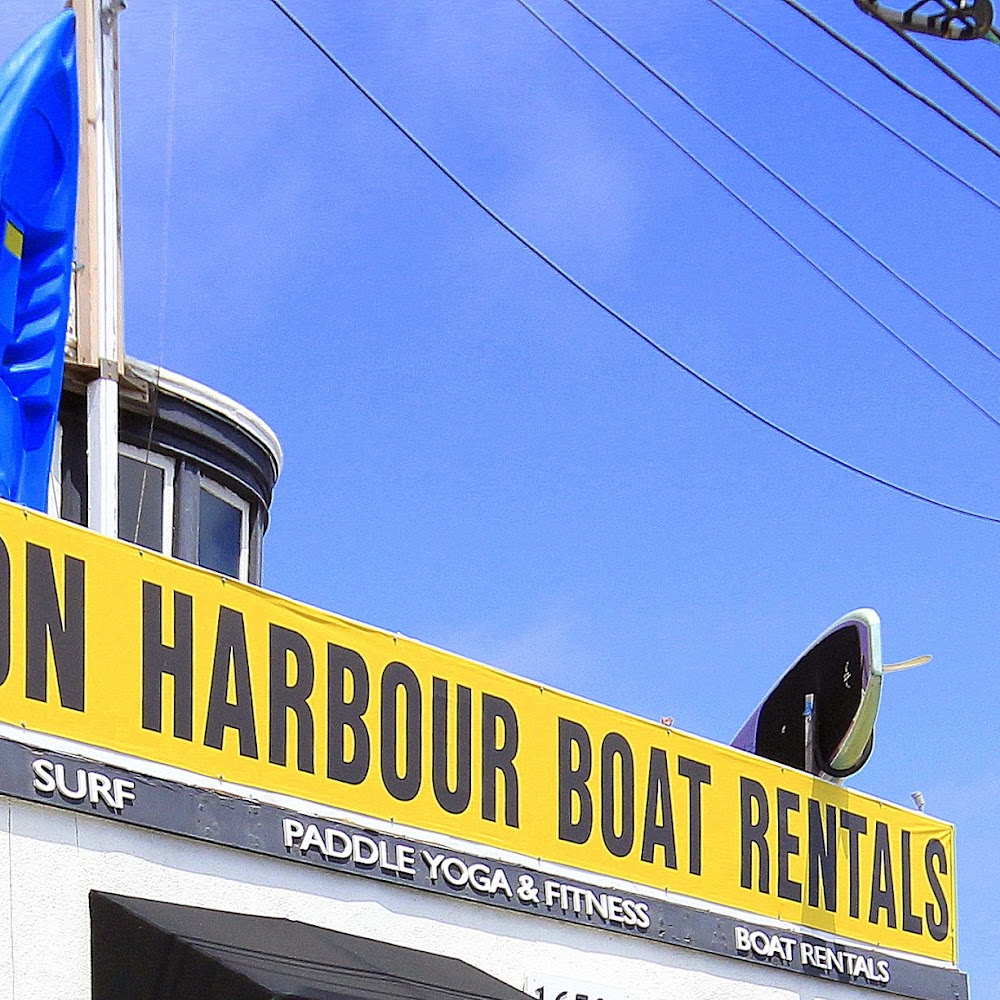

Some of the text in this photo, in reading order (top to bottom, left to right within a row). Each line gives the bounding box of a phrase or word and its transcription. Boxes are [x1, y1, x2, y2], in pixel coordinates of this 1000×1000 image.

[32, 759, 136, 810] SURF
[141, 580, 520, 828] HARBOUR
[558, 717, 711, 877] BOAT
[741, 779, 949, 942] RENTALS
[283, 819, 650, 929] PADDLE YOGA & FITNESS
[735, 926, 890, 983] BOAT RENTALS
